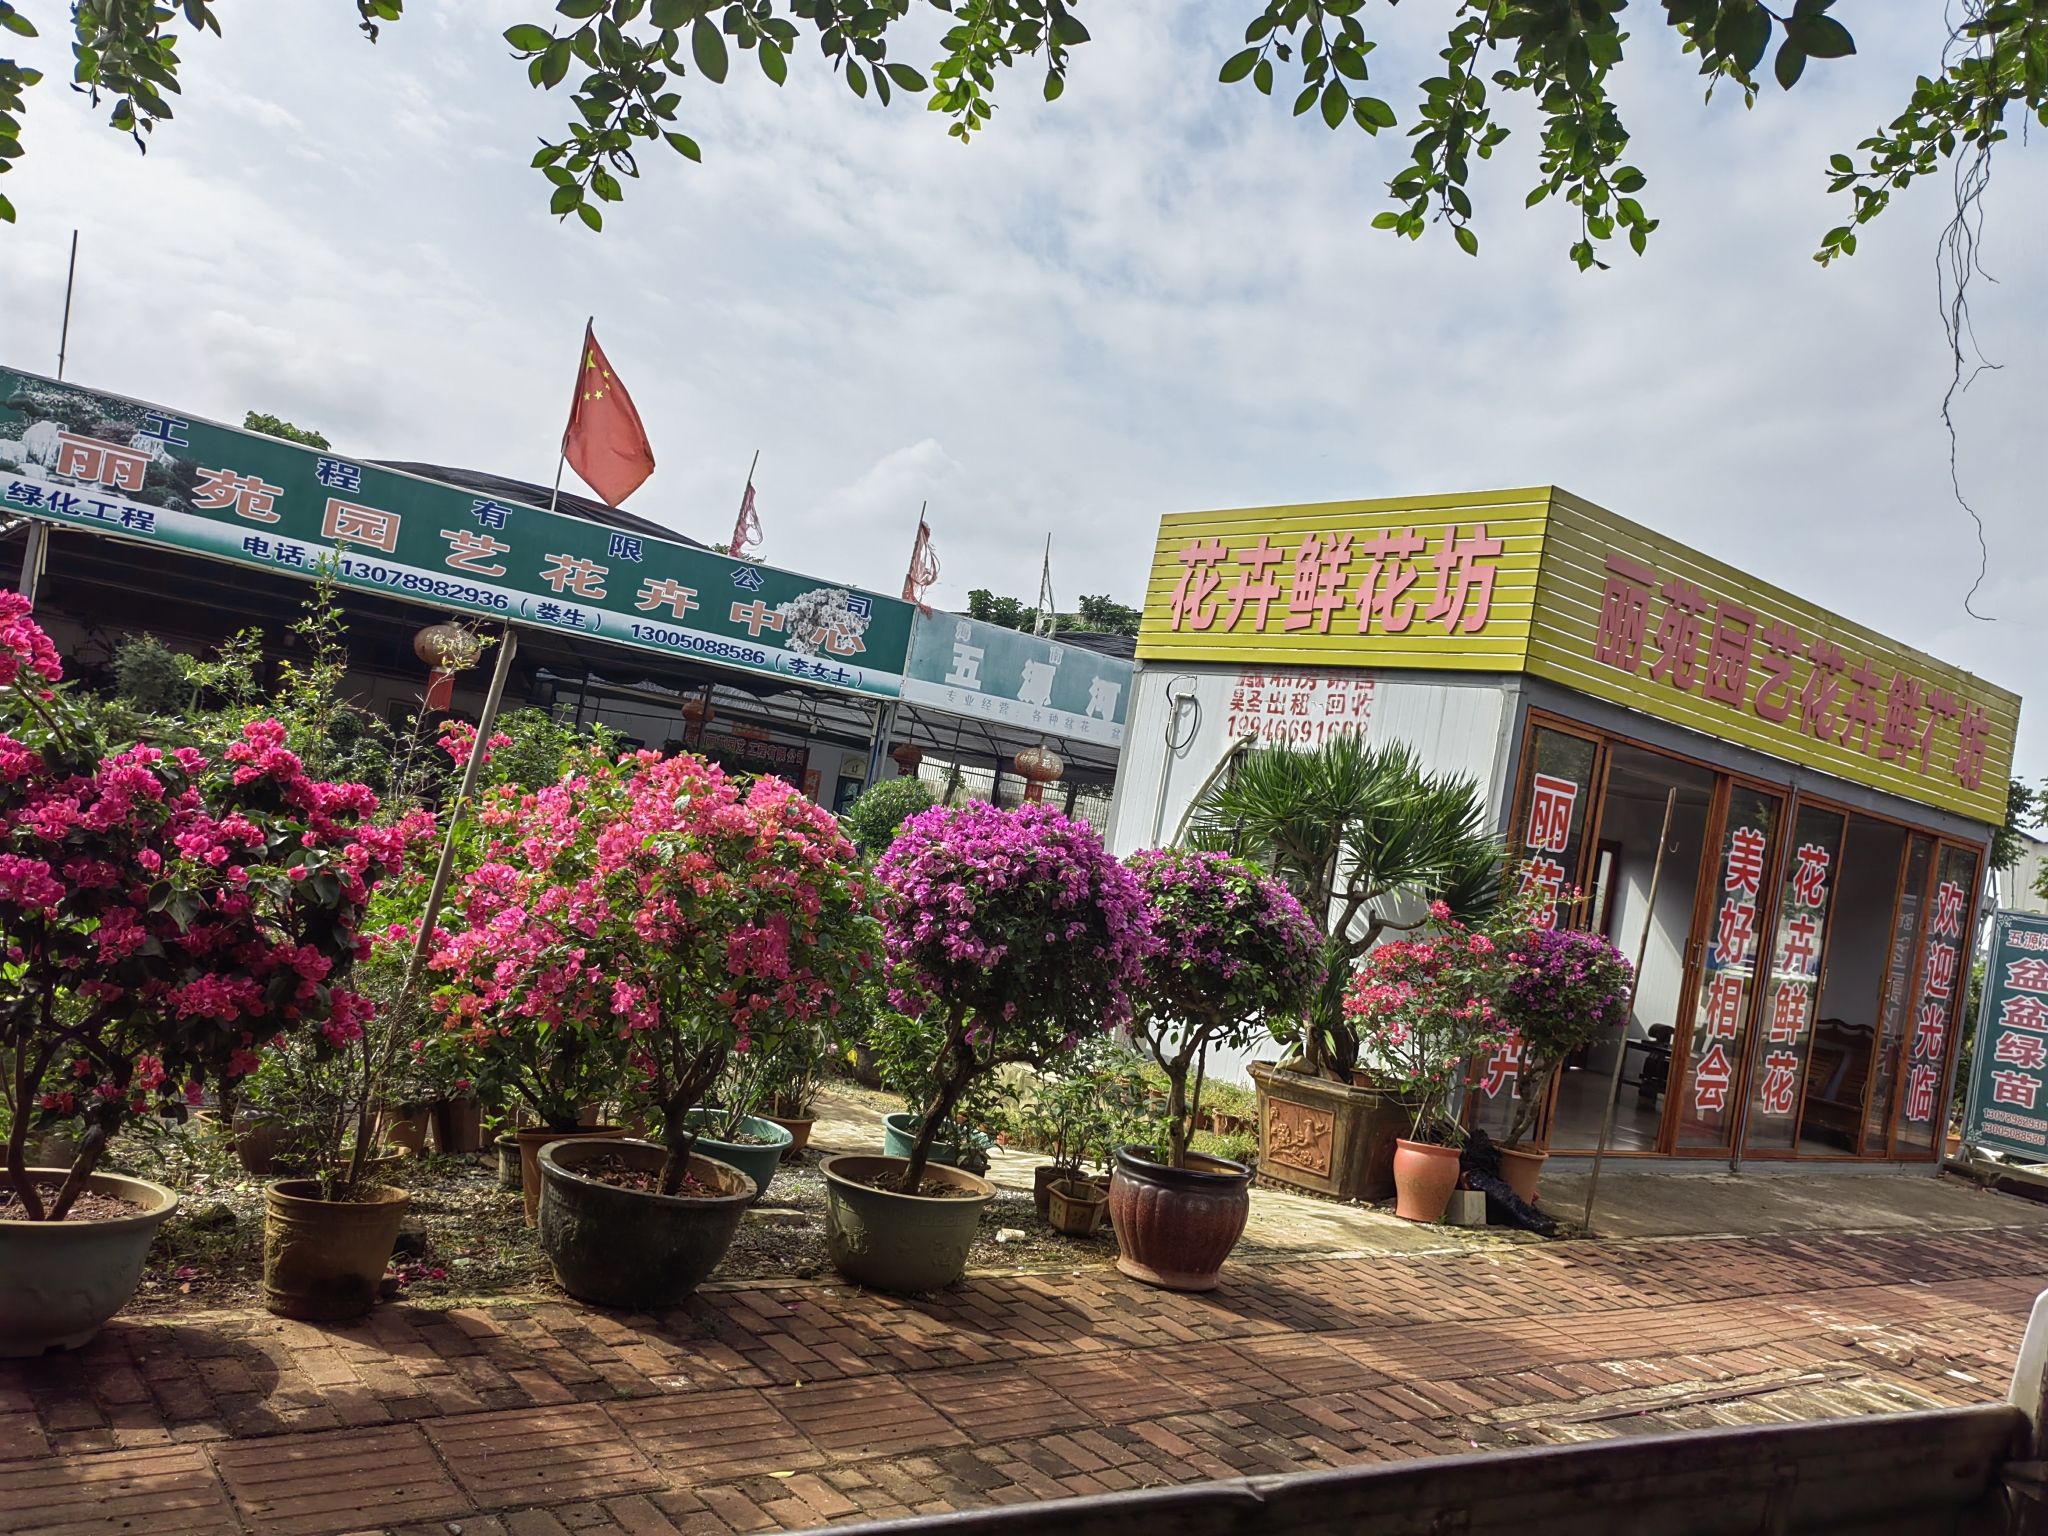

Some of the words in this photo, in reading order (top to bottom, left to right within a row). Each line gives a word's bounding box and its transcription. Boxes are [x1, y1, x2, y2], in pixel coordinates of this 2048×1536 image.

[5, 480, 156, 534] 绿化工程
[57, 430, 868, 657] 丽苑园艺花卉中心
[1170, 523, 1503, 635] 花卉鲜花坊
[1695, 826, 1766, 1112] 美好相会
[1761, 843, 1830, 1114] 花卉鲜花
[1906, 881, 1964, 1122] 欢迎光临
[1991, 957, 2048, 1109] 盆盆绿苗
